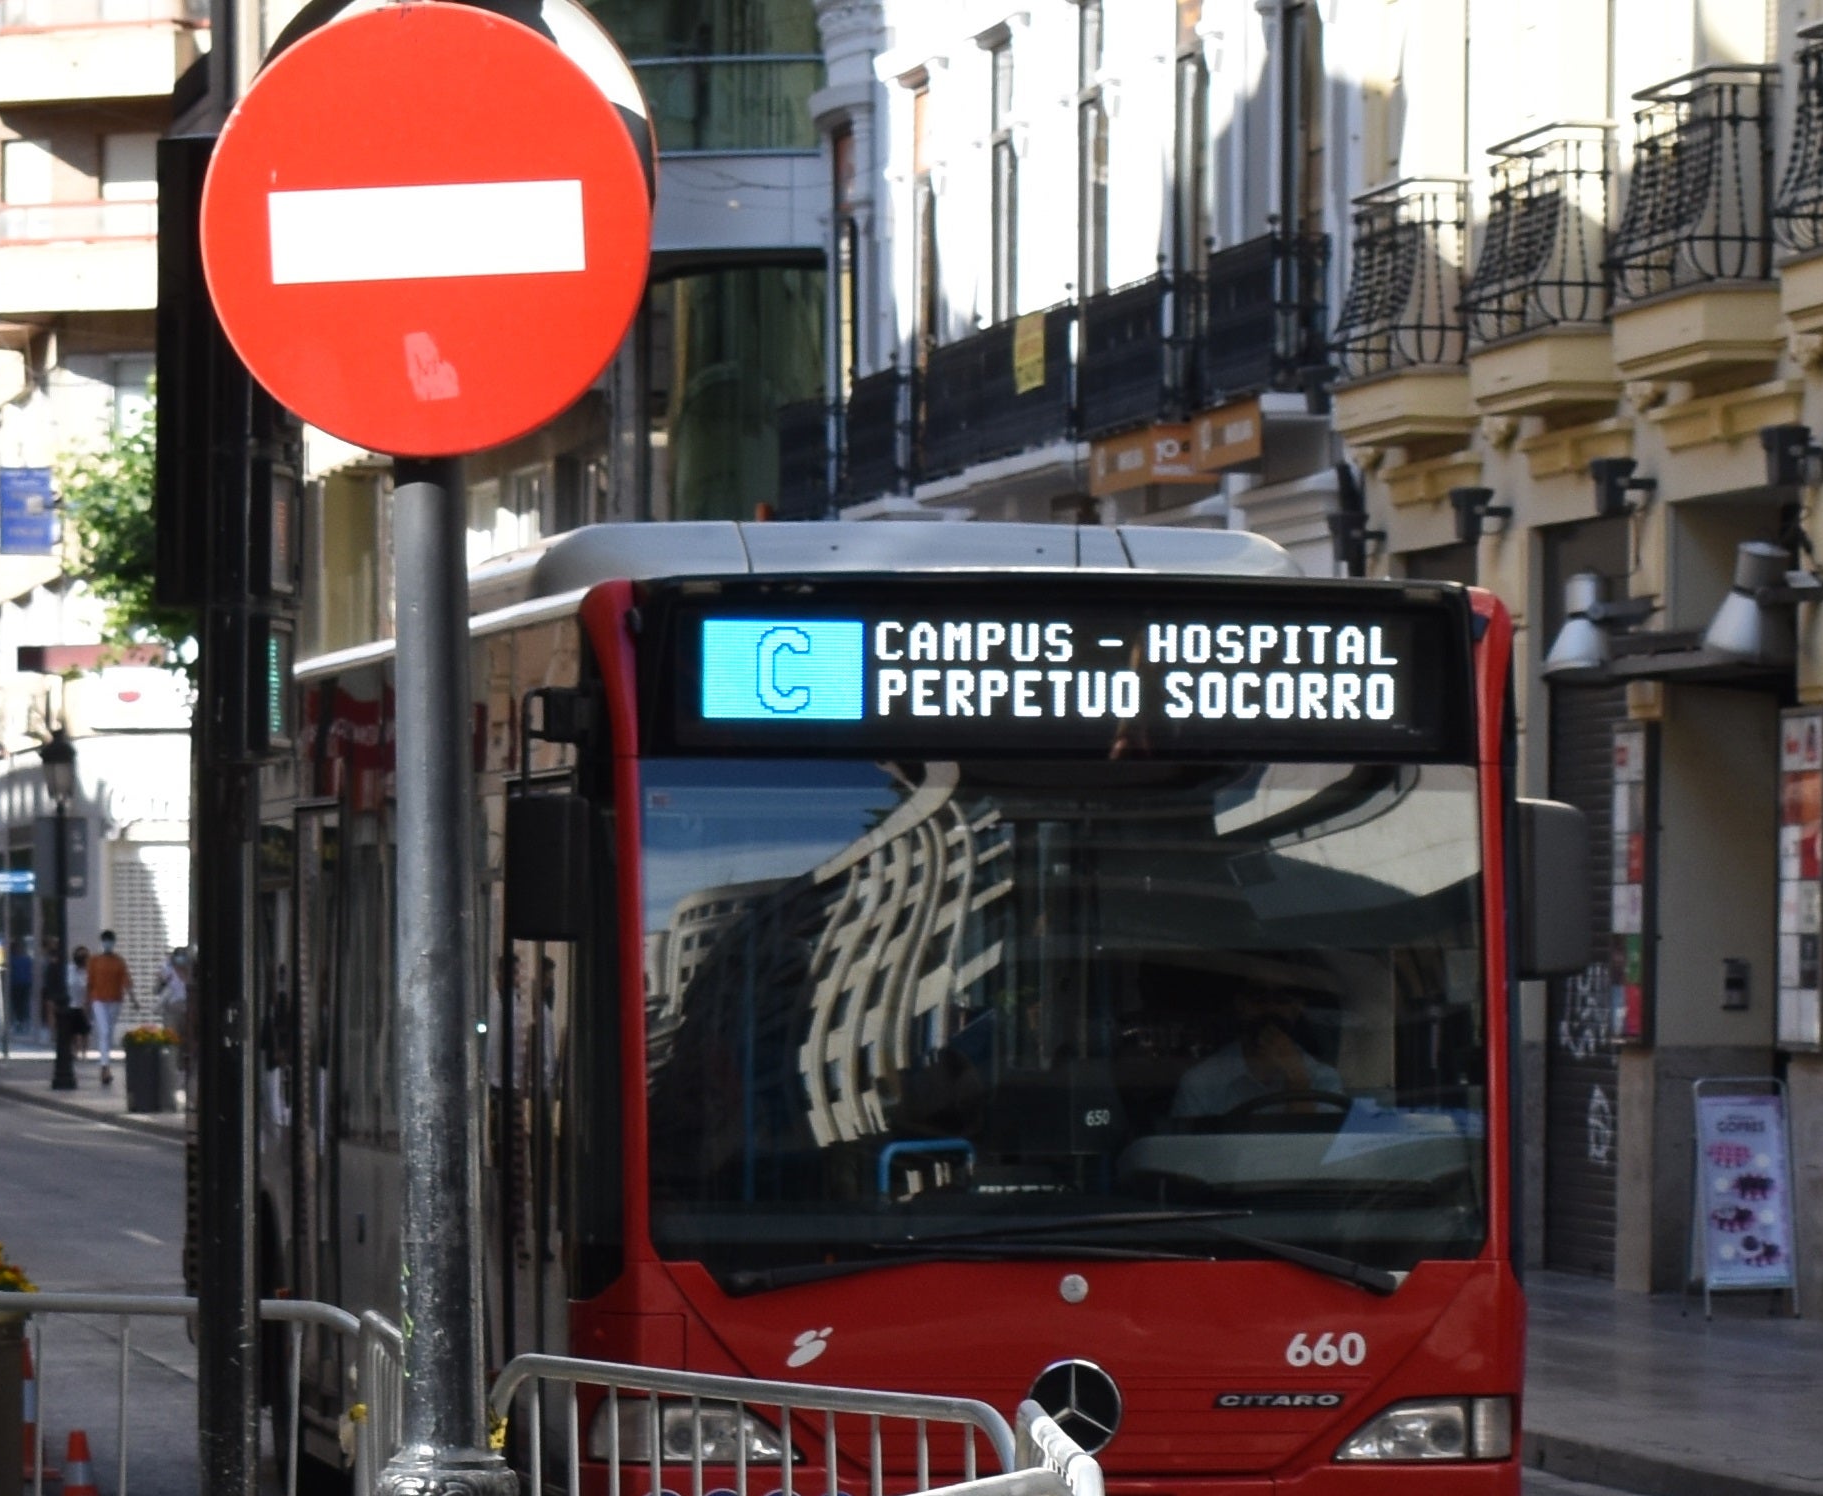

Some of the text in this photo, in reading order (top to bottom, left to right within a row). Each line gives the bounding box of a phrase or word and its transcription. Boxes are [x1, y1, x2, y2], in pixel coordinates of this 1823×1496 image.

[875, 622, 1075, 663] CAMPUS
[1149, 623, 1399, 667] HOSPITAL
[756, 626, 811, 714] C
[877, 671, 1396, 722] PERPETUO SOCORRO
[1286, 1332, 1366, 1367] 660
[1219, 1394, 1340, 1407] CITARO
